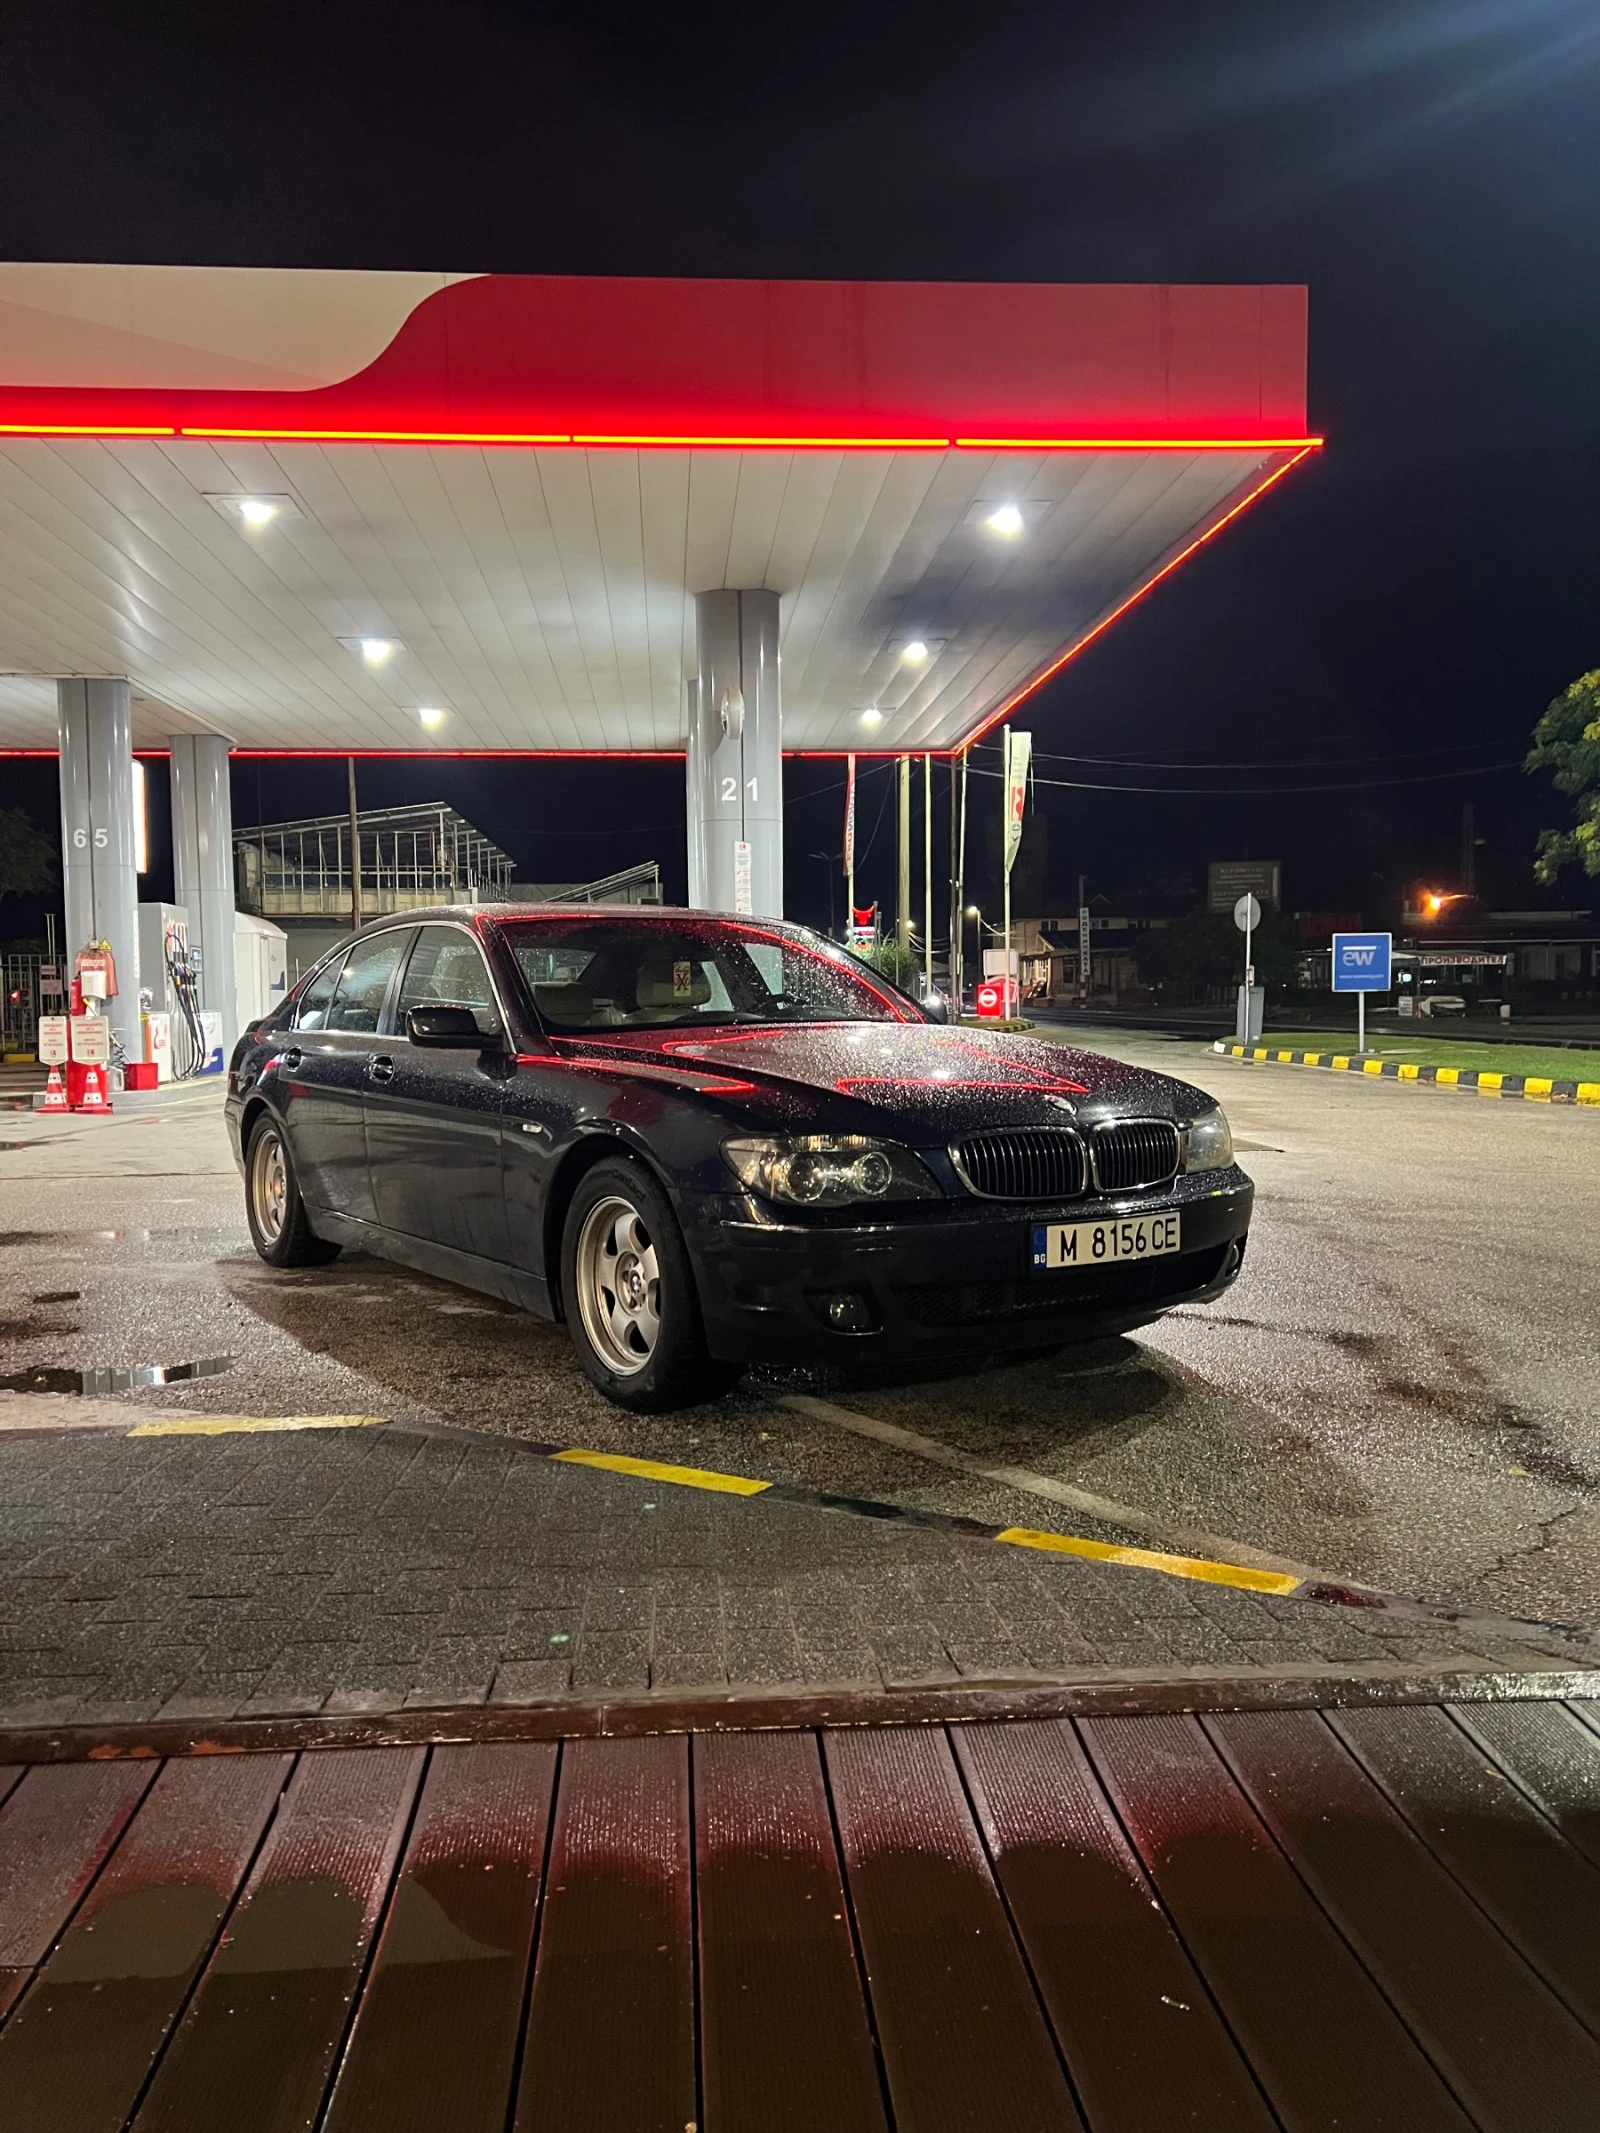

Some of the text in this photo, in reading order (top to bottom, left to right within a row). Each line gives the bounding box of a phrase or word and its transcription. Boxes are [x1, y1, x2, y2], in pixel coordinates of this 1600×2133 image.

[1060, 1217, 1177, 1262] M 8156 CE
[1034, 1253, 1046, 1264] BG
